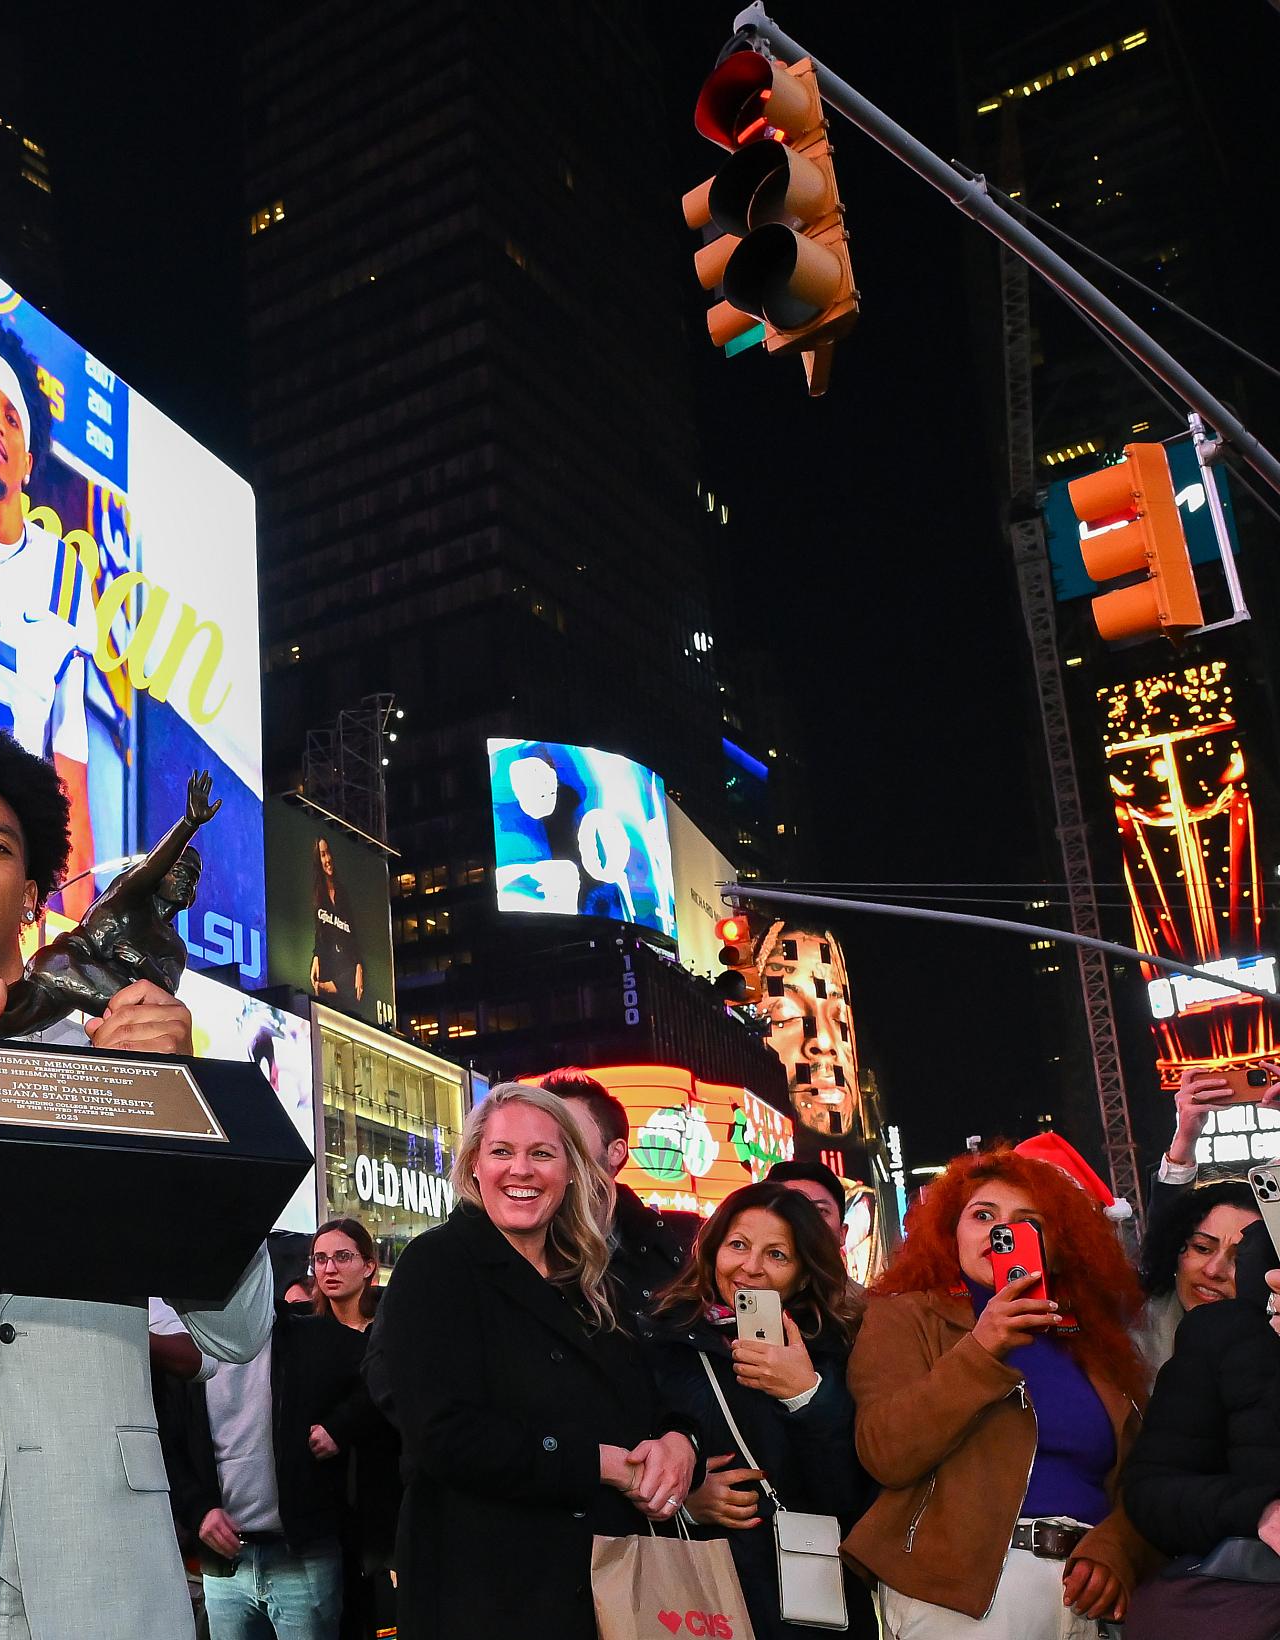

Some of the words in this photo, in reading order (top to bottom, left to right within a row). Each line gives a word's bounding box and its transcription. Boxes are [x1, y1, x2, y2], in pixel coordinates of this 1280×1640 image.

[177, 909, 261, 979] LSU
[622, 954, 640, 1025] 1500
[34, 1066, 75, 1074] PRESENTED
[44, 1060, 109, 1072] MEMORIAL
[112, 1066, 159, 1077] TROPHY
[10, 1069, 58, 1079] HEISMAN
[60, 1073, 100, 1083] TROPHY
[103, 1077, 134, 1086] TRUST
[12, 1081, 58, 1092] JAYDEN
[62, 1086, 113, 1097] DANIELS
[1, 1098, 54, 1107] OUTSTANDING
[55, 1102, 88, 1110] COLLEGE
[89, 1105, 126, 1113] FOOTBALL
[128, 1108, 155, 1116] PLAYER
[42, 1092, 78, 1102] STATE
[82, 1096, 154, 1108] UNIVERSITY
[44, 1106, 73, 1115] UNITED
[55, 1113, 79, 1121] 2023
[355, 1154, 400, 1208] OLD
[401, 1167, 454, 1219] NAVY
[684, 1610, 734, 1639] CVS
